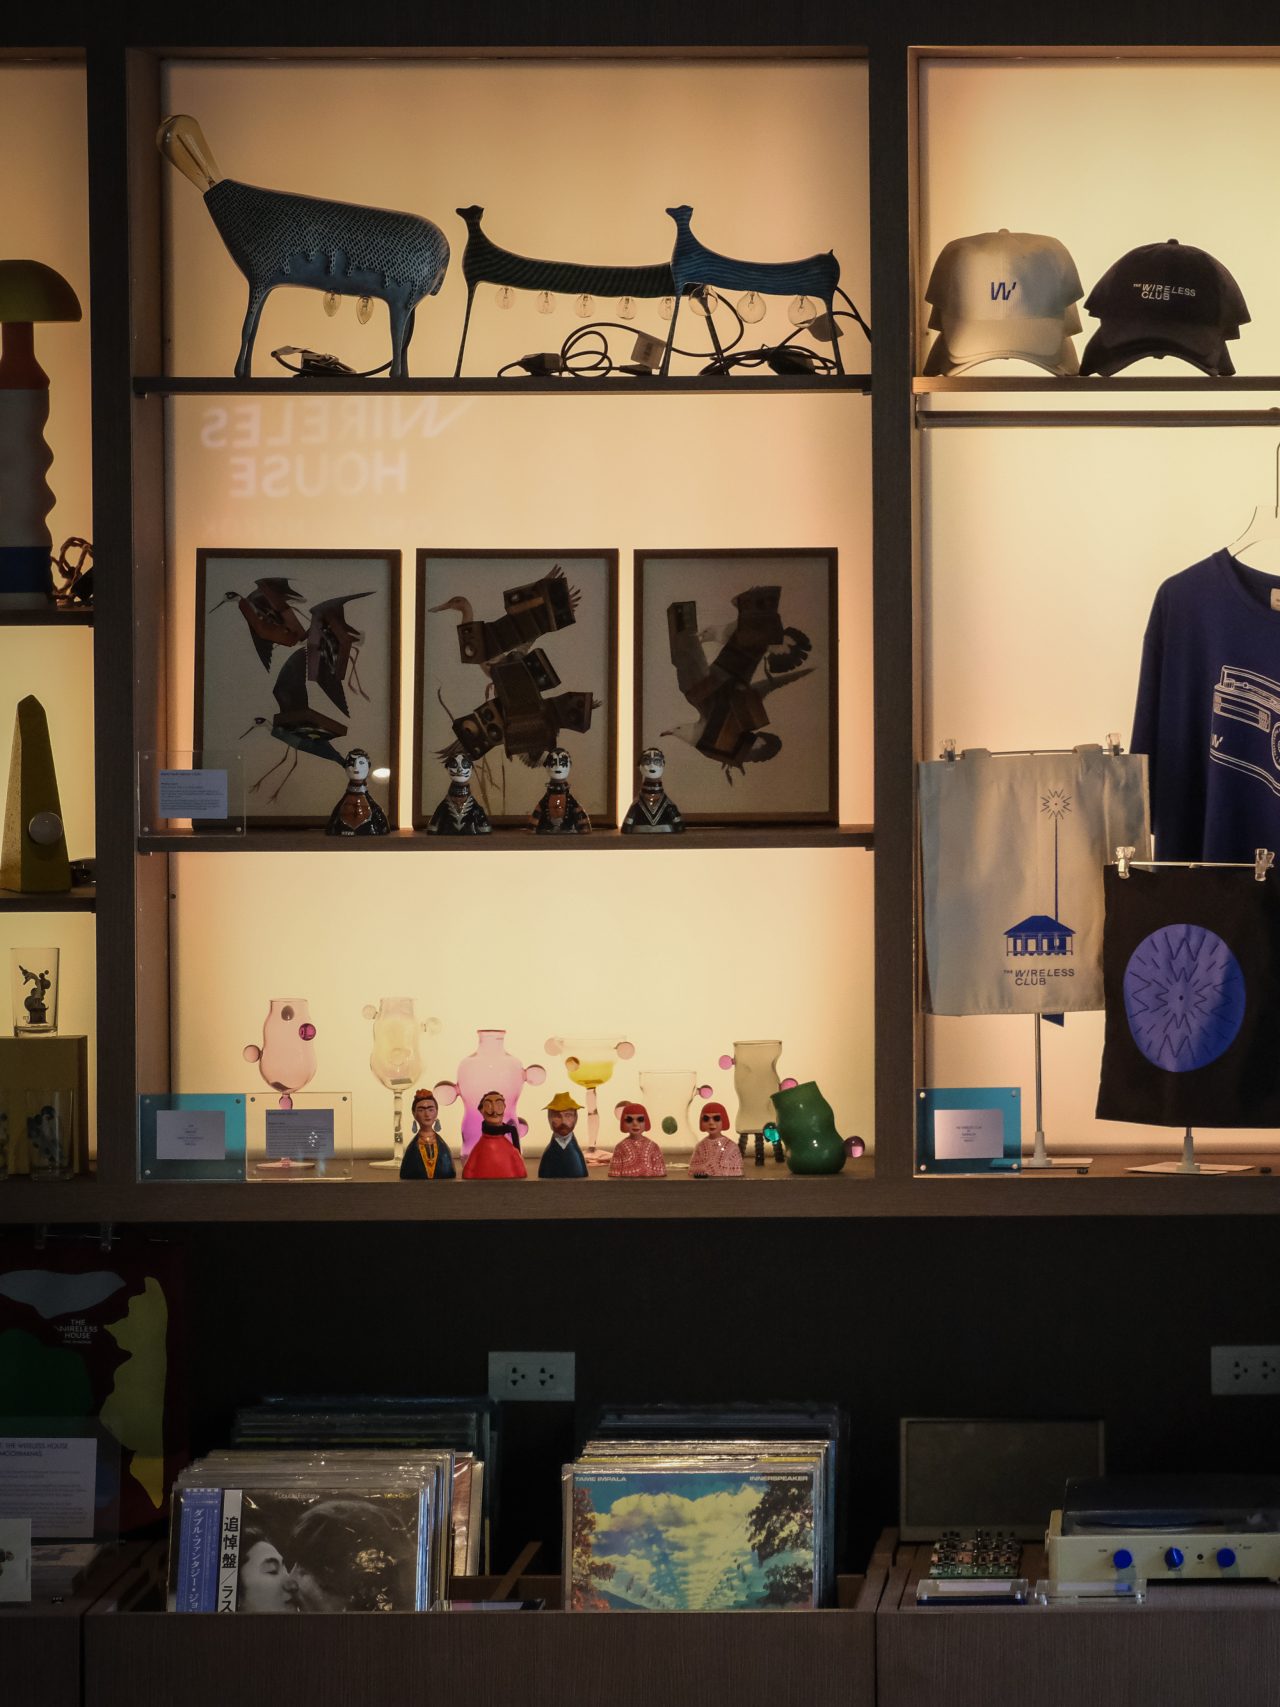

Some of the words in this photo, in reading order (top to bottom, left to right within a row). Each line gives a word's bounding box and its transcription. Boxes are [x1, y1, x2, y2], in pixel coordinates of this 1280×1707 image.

[1142, 283, 1196, 297] WIRELESS
[1141, 291, 1170, 301] CLUB
[1015, 968, 1075, 978] WIRELESS
[1015, 977, 1047, 986] CLUB
[53, 1325, 98, 1333] WIRELESS
[187, 1508, 205, 1612] ダブル・ファンタジー・ジョ
